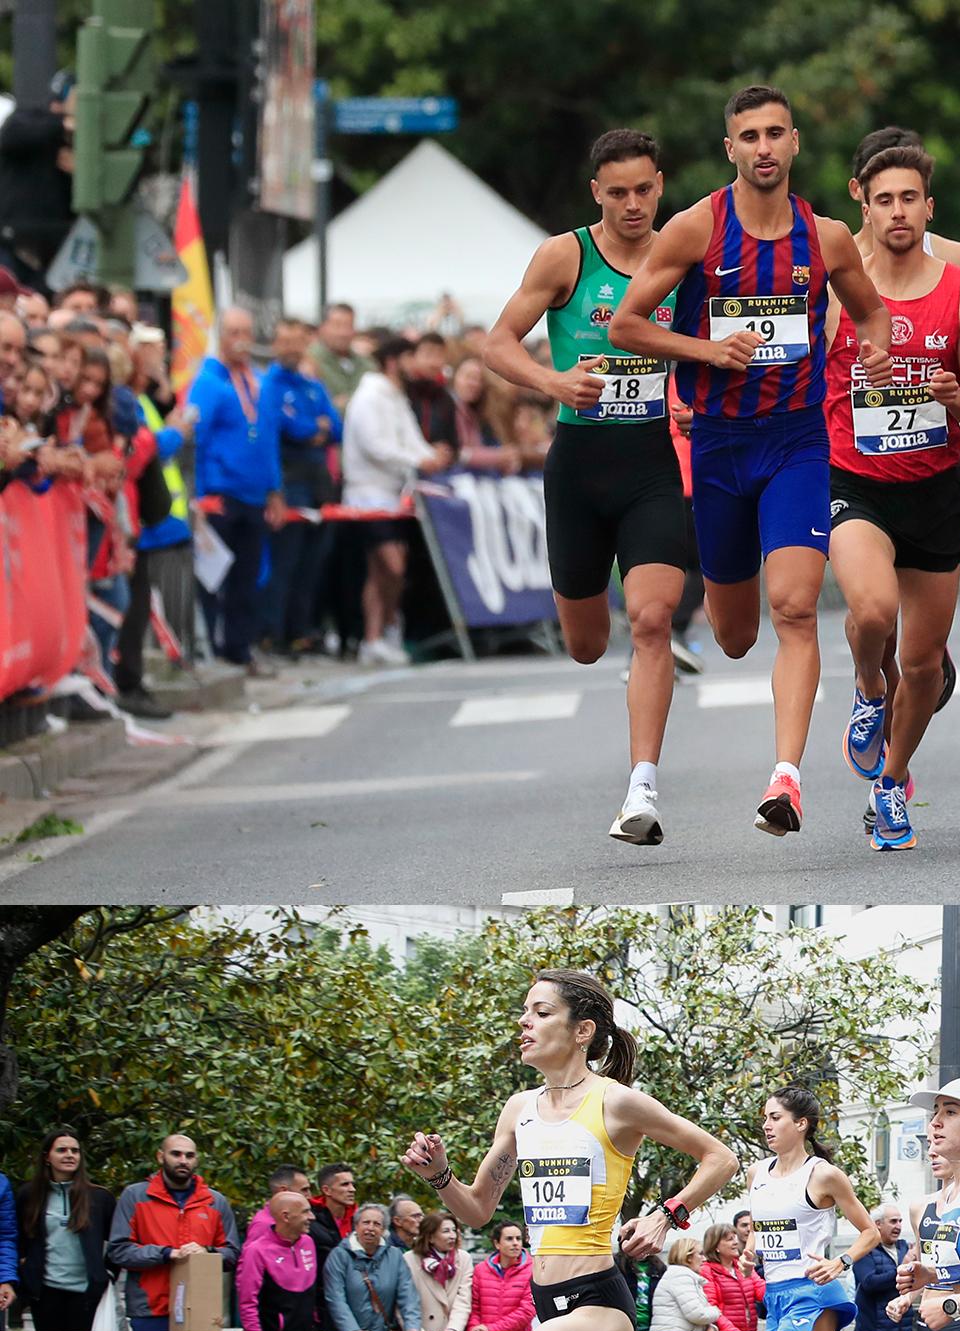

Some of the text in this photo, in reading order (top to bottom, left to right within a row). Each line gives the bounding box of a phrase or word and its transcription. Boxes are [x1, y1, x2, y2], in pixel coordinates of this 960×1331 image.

[748, 298, 796, 307] RUNNING
[760, 308, 788, 316] LOOP
[745, 320, 776, 342] 19
[627, 366, 653, 375] LOOP
[850, 363, 942, 382] ECHE
[611, 378, 640, 400] 18
[889, 386, 930, 396] RUNNIN
[902, 395, 930, 405] LOOP
[598, 402, 648, 418] Joma
[886, 408, 917, 432] 27
[878, 431, 930, 452] Joma
[539, 1159, 579, 1167] RUNNING
[548, 1168, 571, 1176] LOOP
[532, 1180, 566, 1204] 104
[531, 1206, 568, 1223] Joma
[761, 1234, 784, 1249] 102
